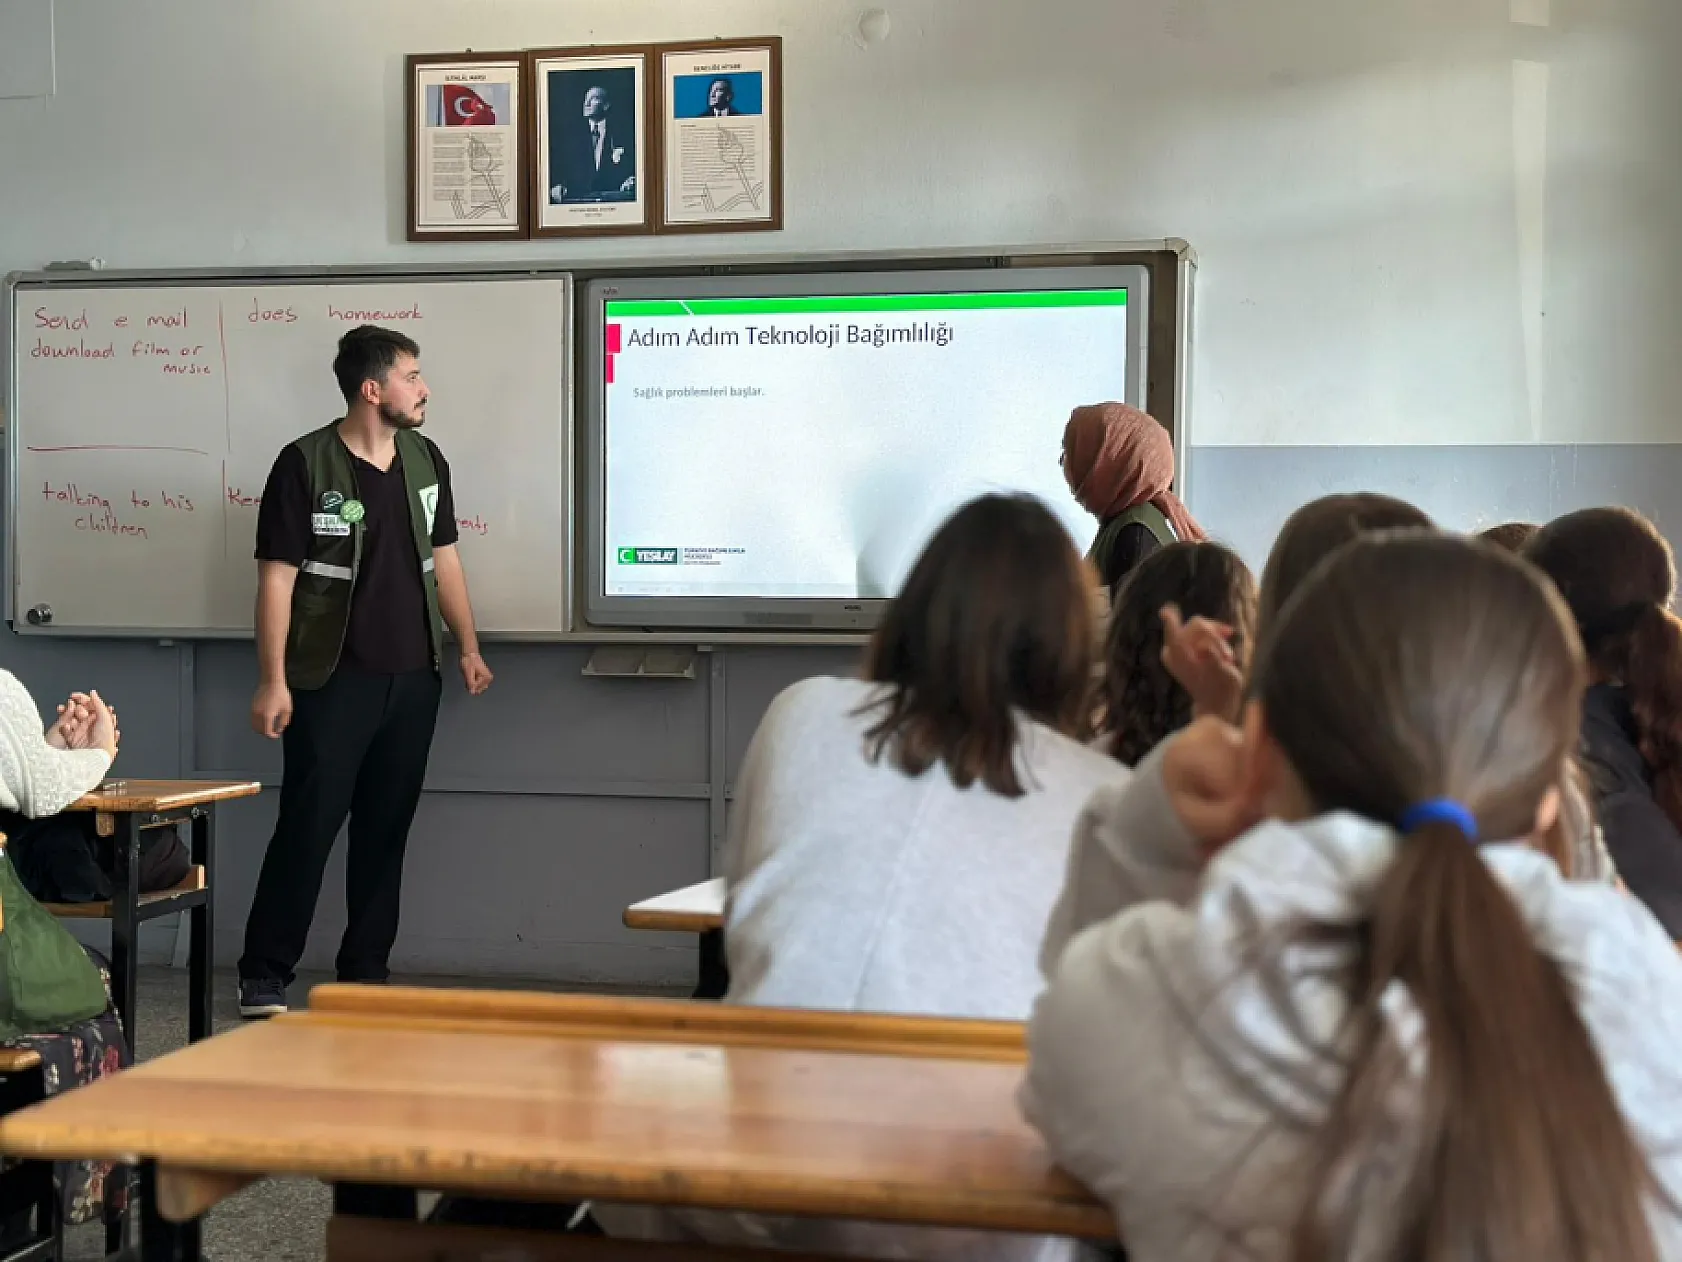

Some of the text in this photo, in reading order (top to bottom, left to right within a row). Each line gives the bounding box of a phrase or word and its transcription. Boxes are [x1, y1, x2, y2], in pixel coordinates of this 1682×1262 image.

[34, 306, 89, 330] Send
[146, 305, 187, 329] mail
[248, 297, 423, 323] does homework
[31, 336, 204, 359] download film or
[627, 321, 954, 349] Adım Adım Teknoloji Bağımlılığı
[163, 363, 211, 375] music
[665, 386, 728, 400] problemleri
[42, 481, 194, 519] talking to his
[75, 511, 149, 540] children
